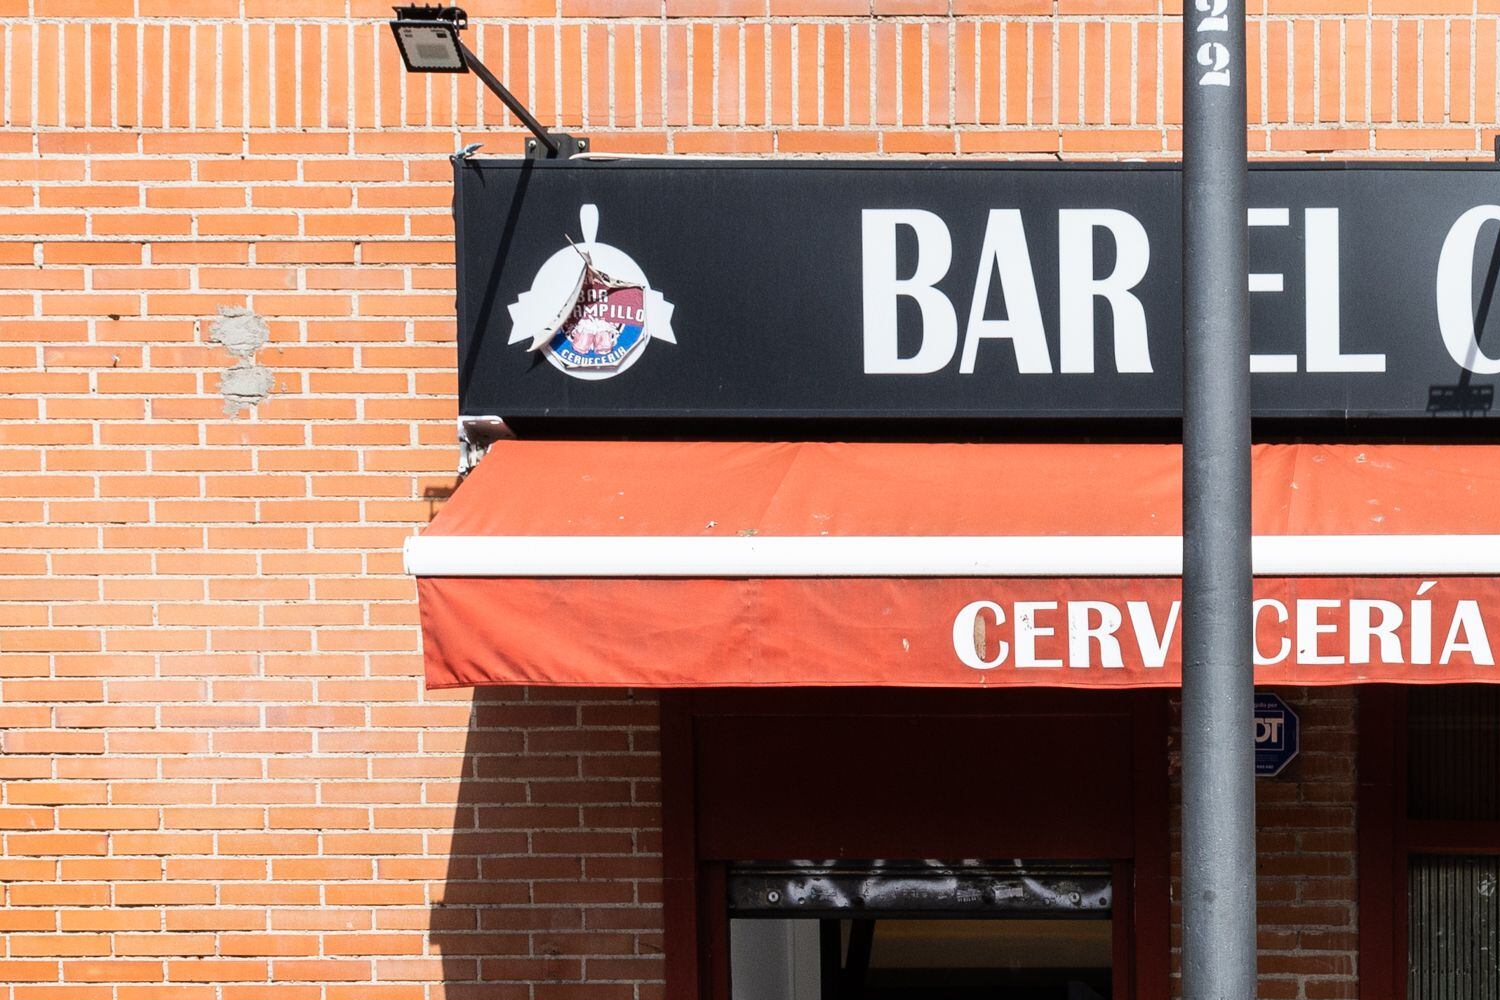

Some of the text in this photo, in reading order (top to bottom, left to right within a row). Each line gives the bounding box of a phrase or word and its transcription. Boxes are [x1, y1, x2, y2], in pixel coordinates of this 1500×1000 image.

[571, 303, 644, 322] AMPILLO
[861, 207, 1154, 375] BAR
[952, 580, 1496, 670] CERVCERÍA
[1254, 717, 1284, 743] DT
